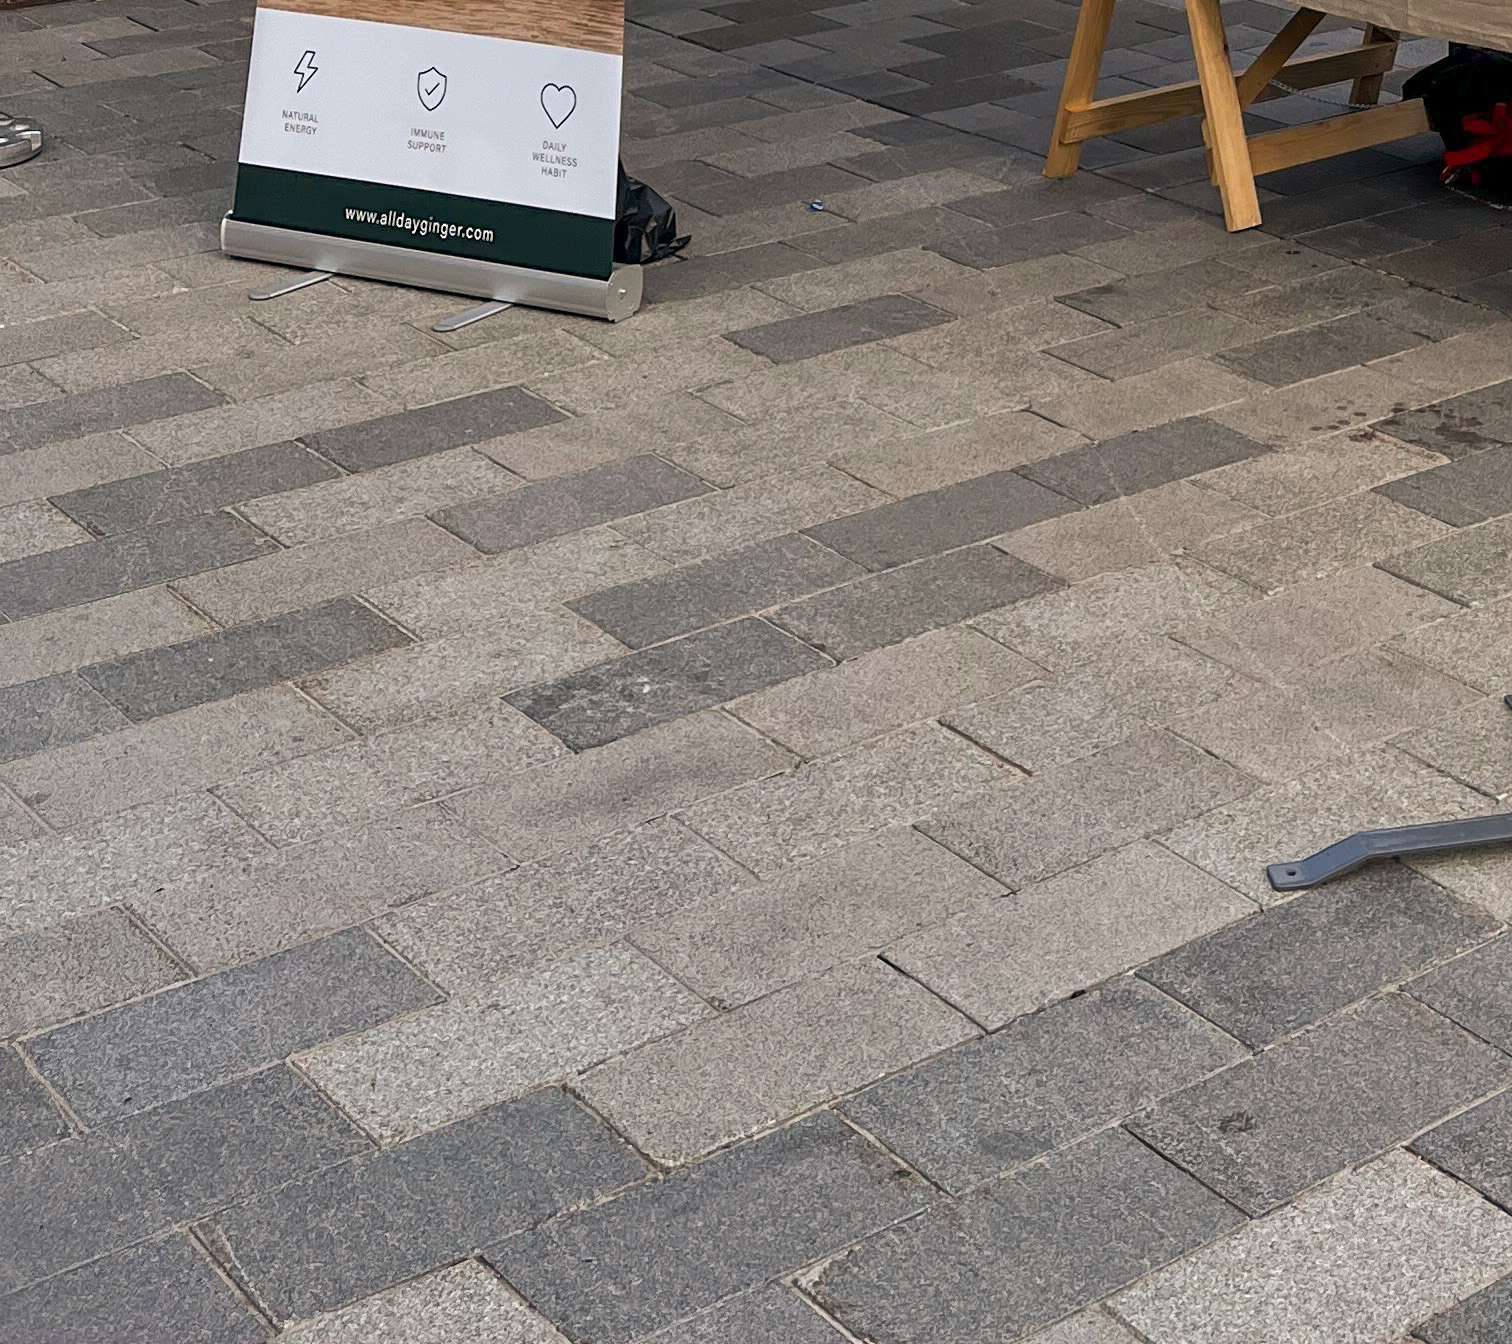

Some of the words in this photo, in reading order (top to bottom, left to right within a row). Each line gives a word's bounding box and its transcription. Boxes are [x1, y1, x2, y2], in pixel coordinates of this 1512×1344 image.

[282, 110, 319, 123] NATURAL
[284, 122, 317, 136] ENERGY
[410, 128, 445, 141] IMMUNE
[407, 140, 446, 154] SUPPORT
[542, 140, 567, 152] DAILY
[532, 152, 578, 168] WELLNESS
[541, 166, 567, 178] HABIT
[344, 207, 494, 243] www.alldayginger.com
